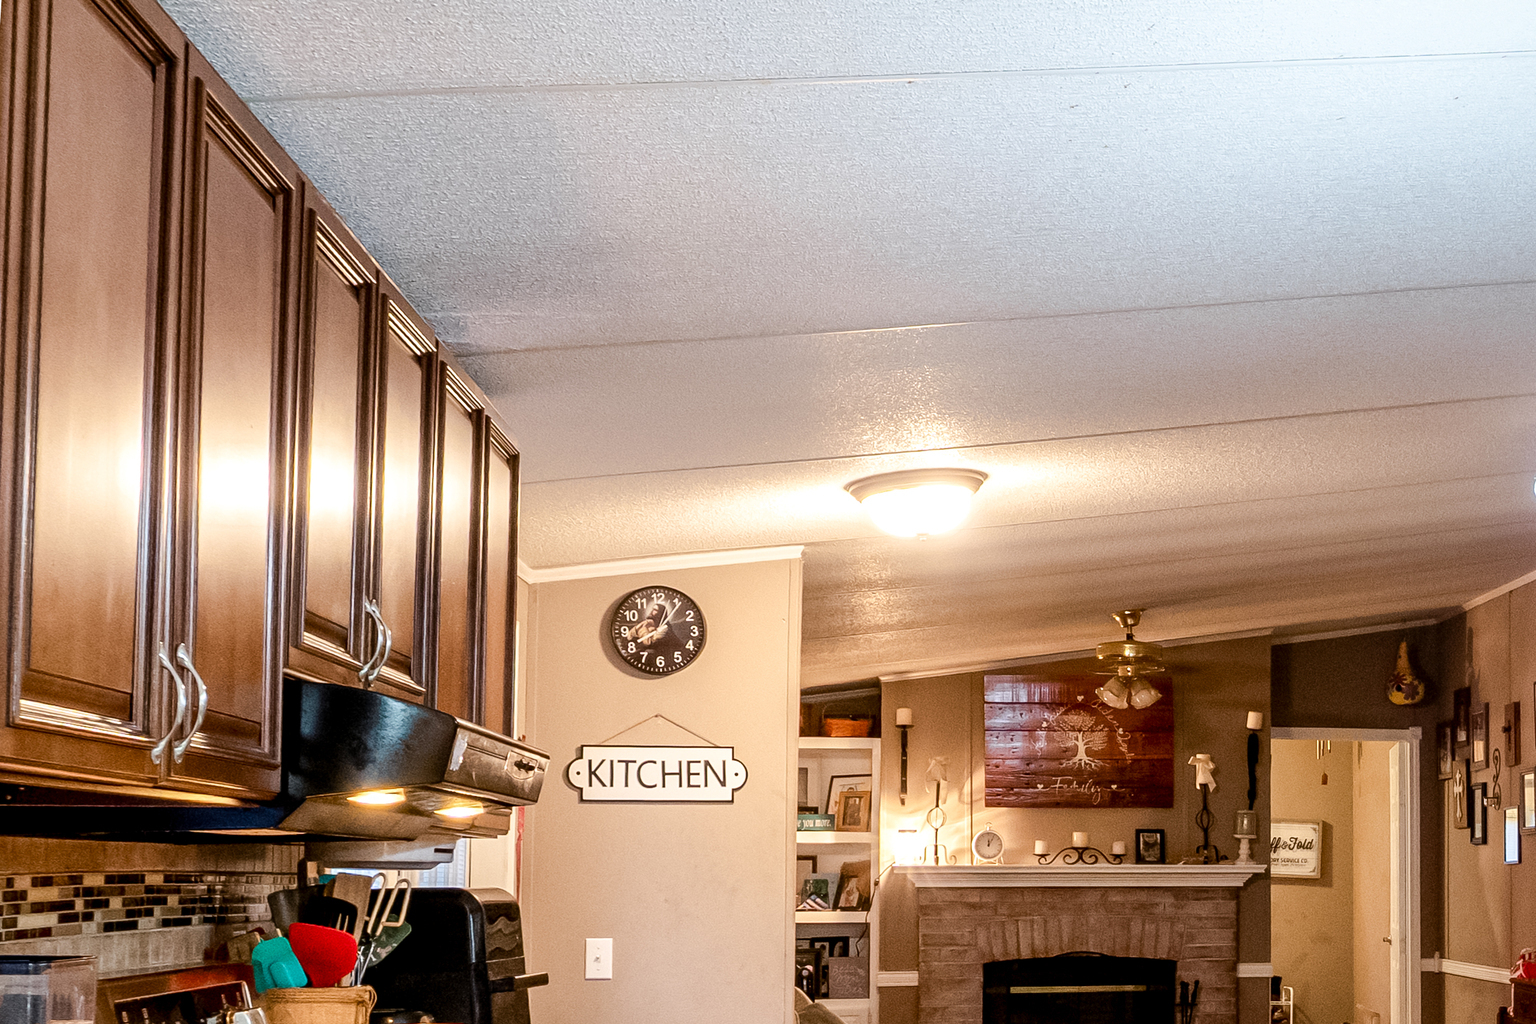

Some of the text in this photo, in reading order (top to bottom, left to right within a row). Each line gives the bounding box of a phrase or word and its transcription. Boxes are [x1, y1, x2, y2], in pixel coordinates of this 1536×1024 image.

[635, 598, 647, 609] 11
[651, 592, 665, 604] 12
[624, 610, 694, 621] 10 2
[620, 625, 698, 637] 9 3
[627, 641, 636, 653] 8
[685, 640, 694, 651] 4
[640, 651, 682, 667] 7 6 5
[587, 759, 727, 788] KITCHEN
[801, 819, 814, 830] you
[1270, 837, 1281, 853] ff
